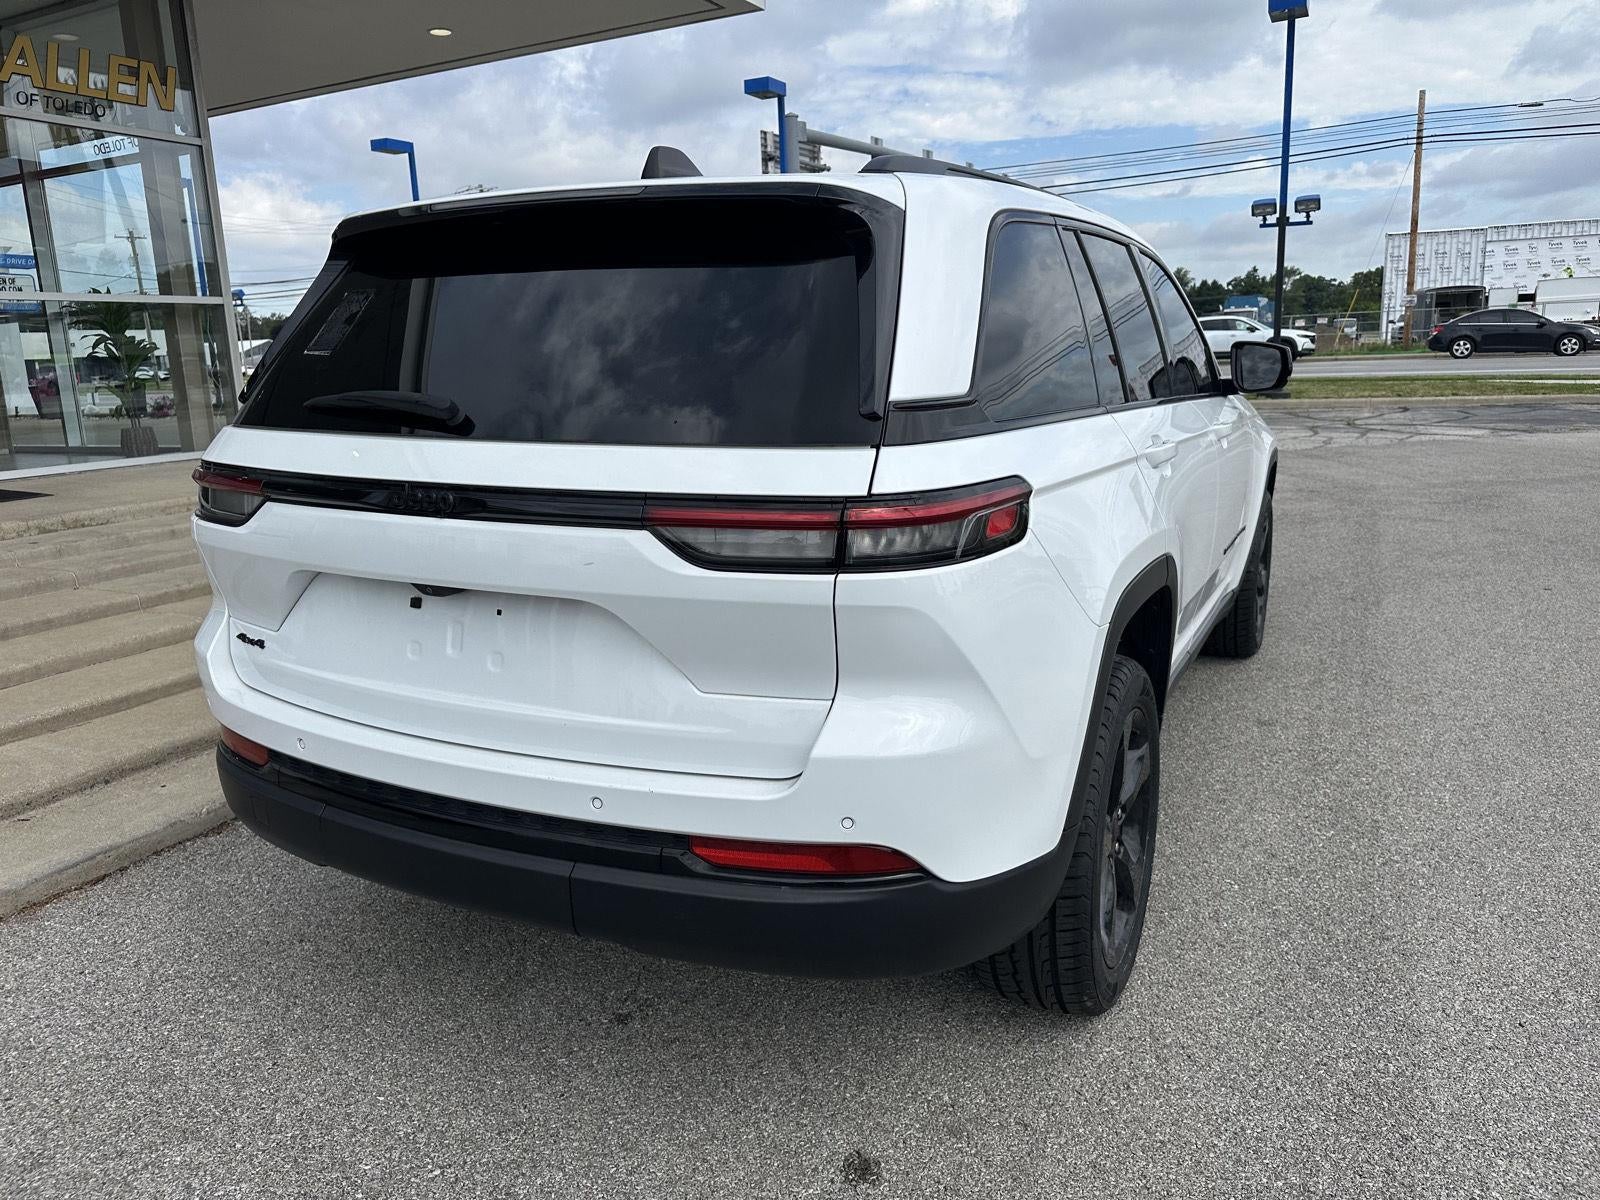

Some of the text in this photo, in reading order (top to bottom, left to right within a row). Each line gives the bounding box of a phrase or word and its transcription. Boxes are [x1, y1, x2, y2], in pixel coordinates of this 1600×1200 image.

[0, 34, 176, 112] ALLEN
[16, 91, 106, 117] OF TOLEDO
[236, 633, 266, 650] 4x4
